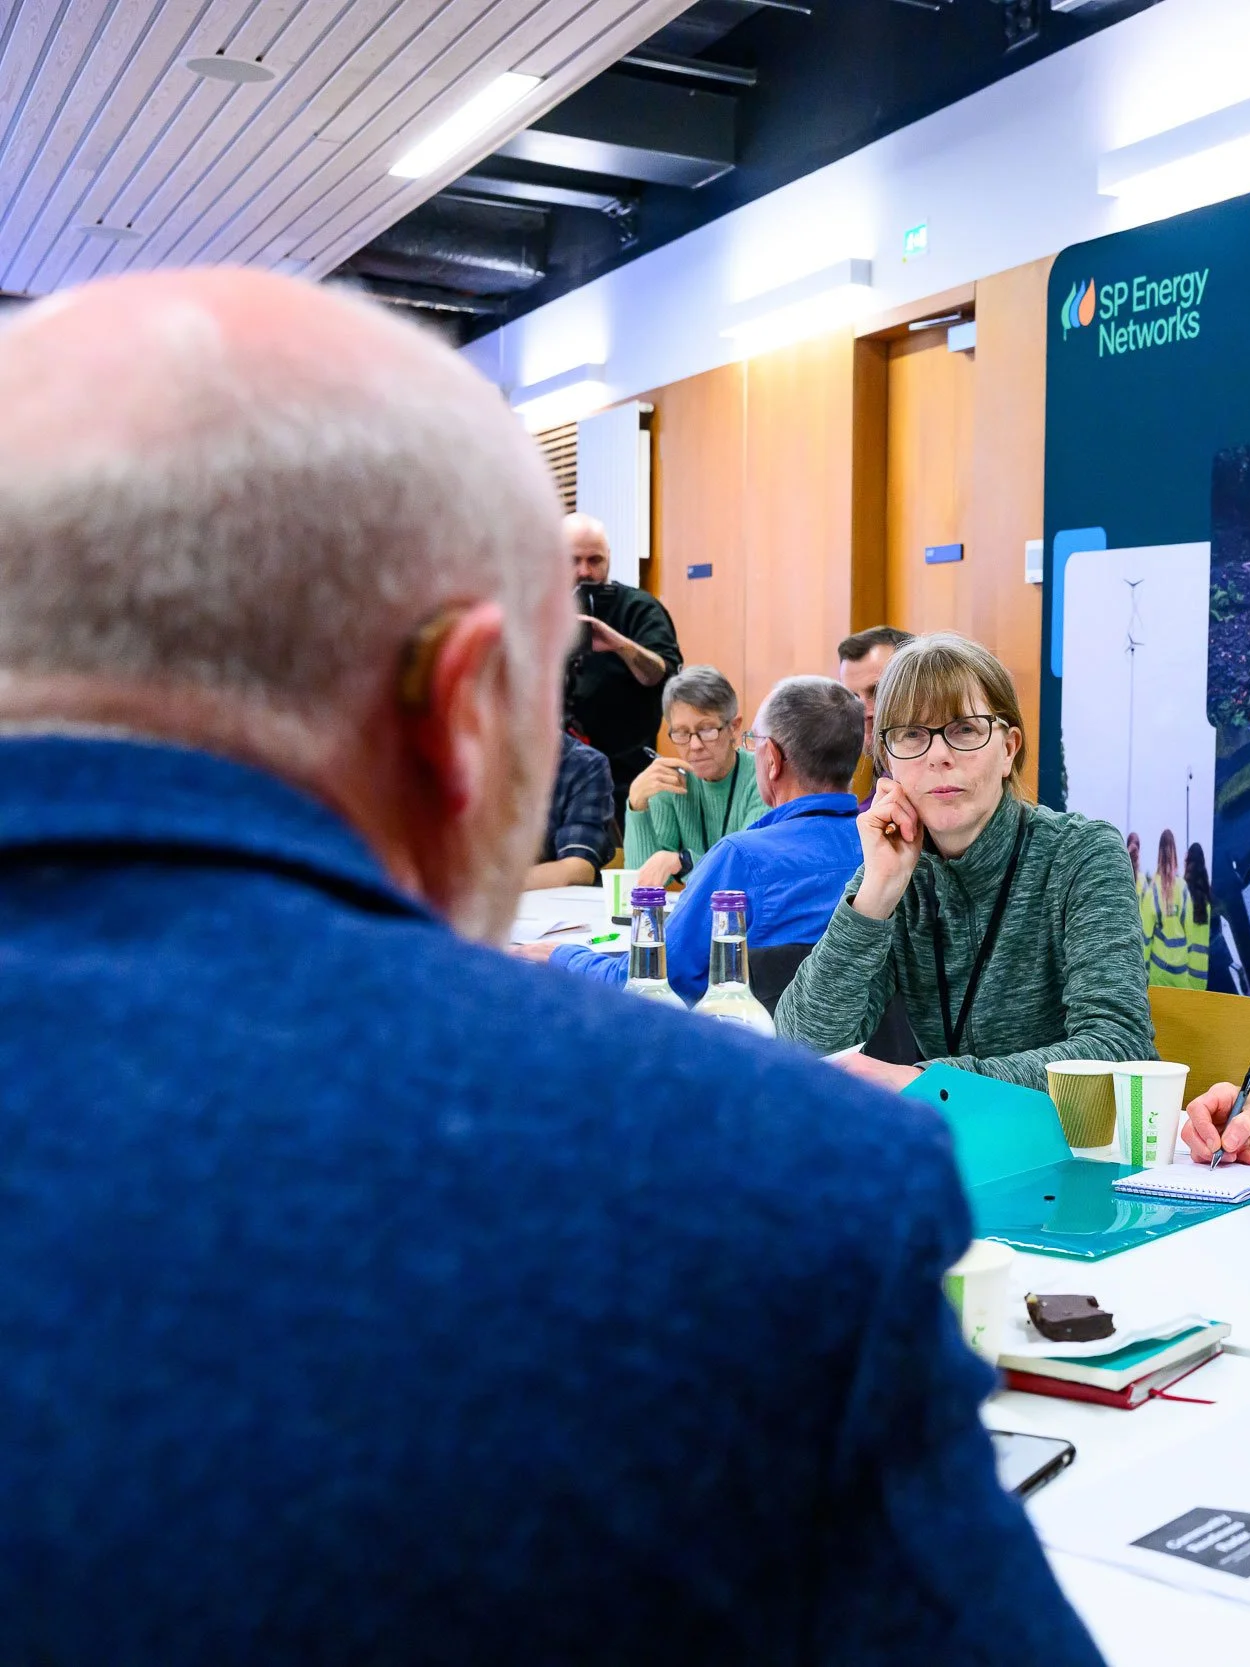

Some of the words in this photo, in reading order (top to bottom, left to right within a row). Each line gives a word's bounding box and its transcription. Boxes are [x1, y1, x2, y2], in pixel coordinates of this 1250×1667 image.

[1099, 282, 1128, 319] SP
[1132, 268, 1209, 312] Energy
[1099, 306, 1200, 357] Networks
